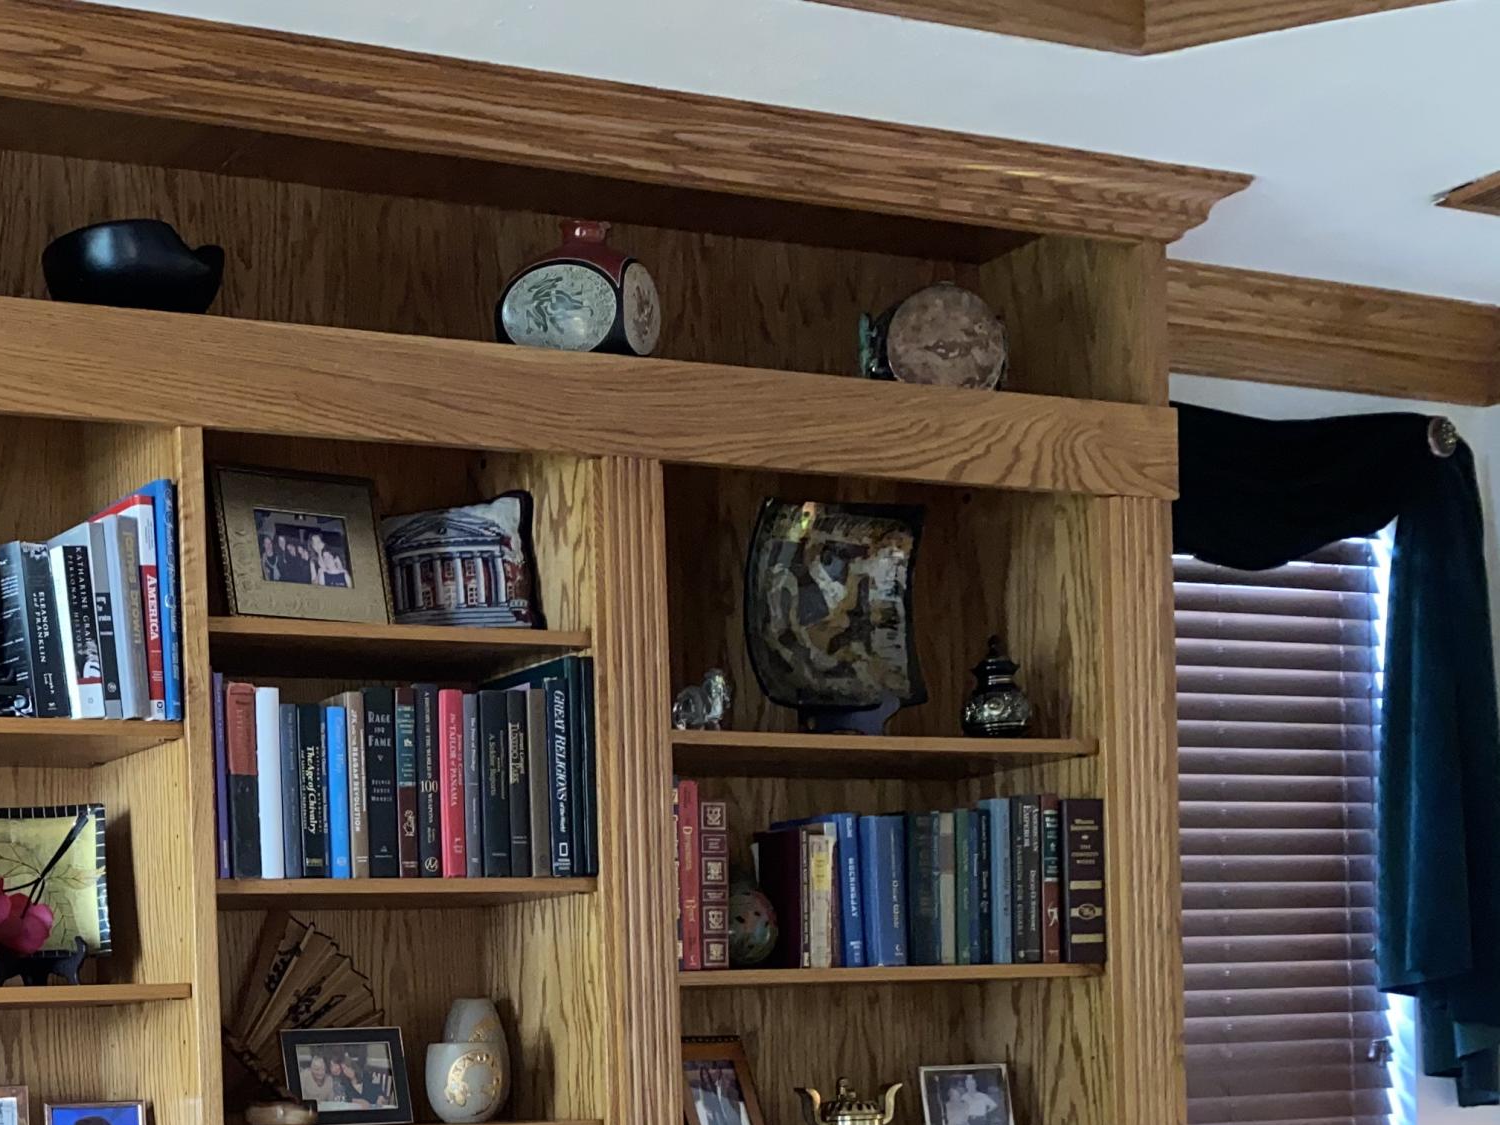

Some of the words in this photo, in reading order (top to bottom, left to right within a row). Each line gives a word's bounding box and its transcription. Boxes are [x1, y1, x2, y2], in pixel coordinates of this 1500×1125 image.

[75, 547, 89, 610] KATHARINE
[122, 532, 137, 584] james
[38, 591, 49, 638] ELEANOR
[67, 555, 78, 606] PERSONAL
[73, 612, 84, 655] HISTORY
[129, 590, 142, 644] brown
[146, 574, 159, 641] AMERICA
[34, 612, 46, 663] FRANKLIN
[367, 711, 391, 723] RAGE
[554, 690, 566, 732] GREAT
[306, 745, 315, 765] The
[368, 735, 391, 747] FAME
[449, 726, 457, 759] TAILOR
[306, 765, 316, 782] Age
[306, 782, 317, 793] of
[421, 780, 438, 792] 100
[450, 768, 458, 807] PANAMA
[555, 734, 567, 801] RELIGIONS
[307, 793, 317, 834] Chivalry
[353, 781, 361, 832] REVOLUTION
[848, 857, 858, 917] MOCKINGJAY
